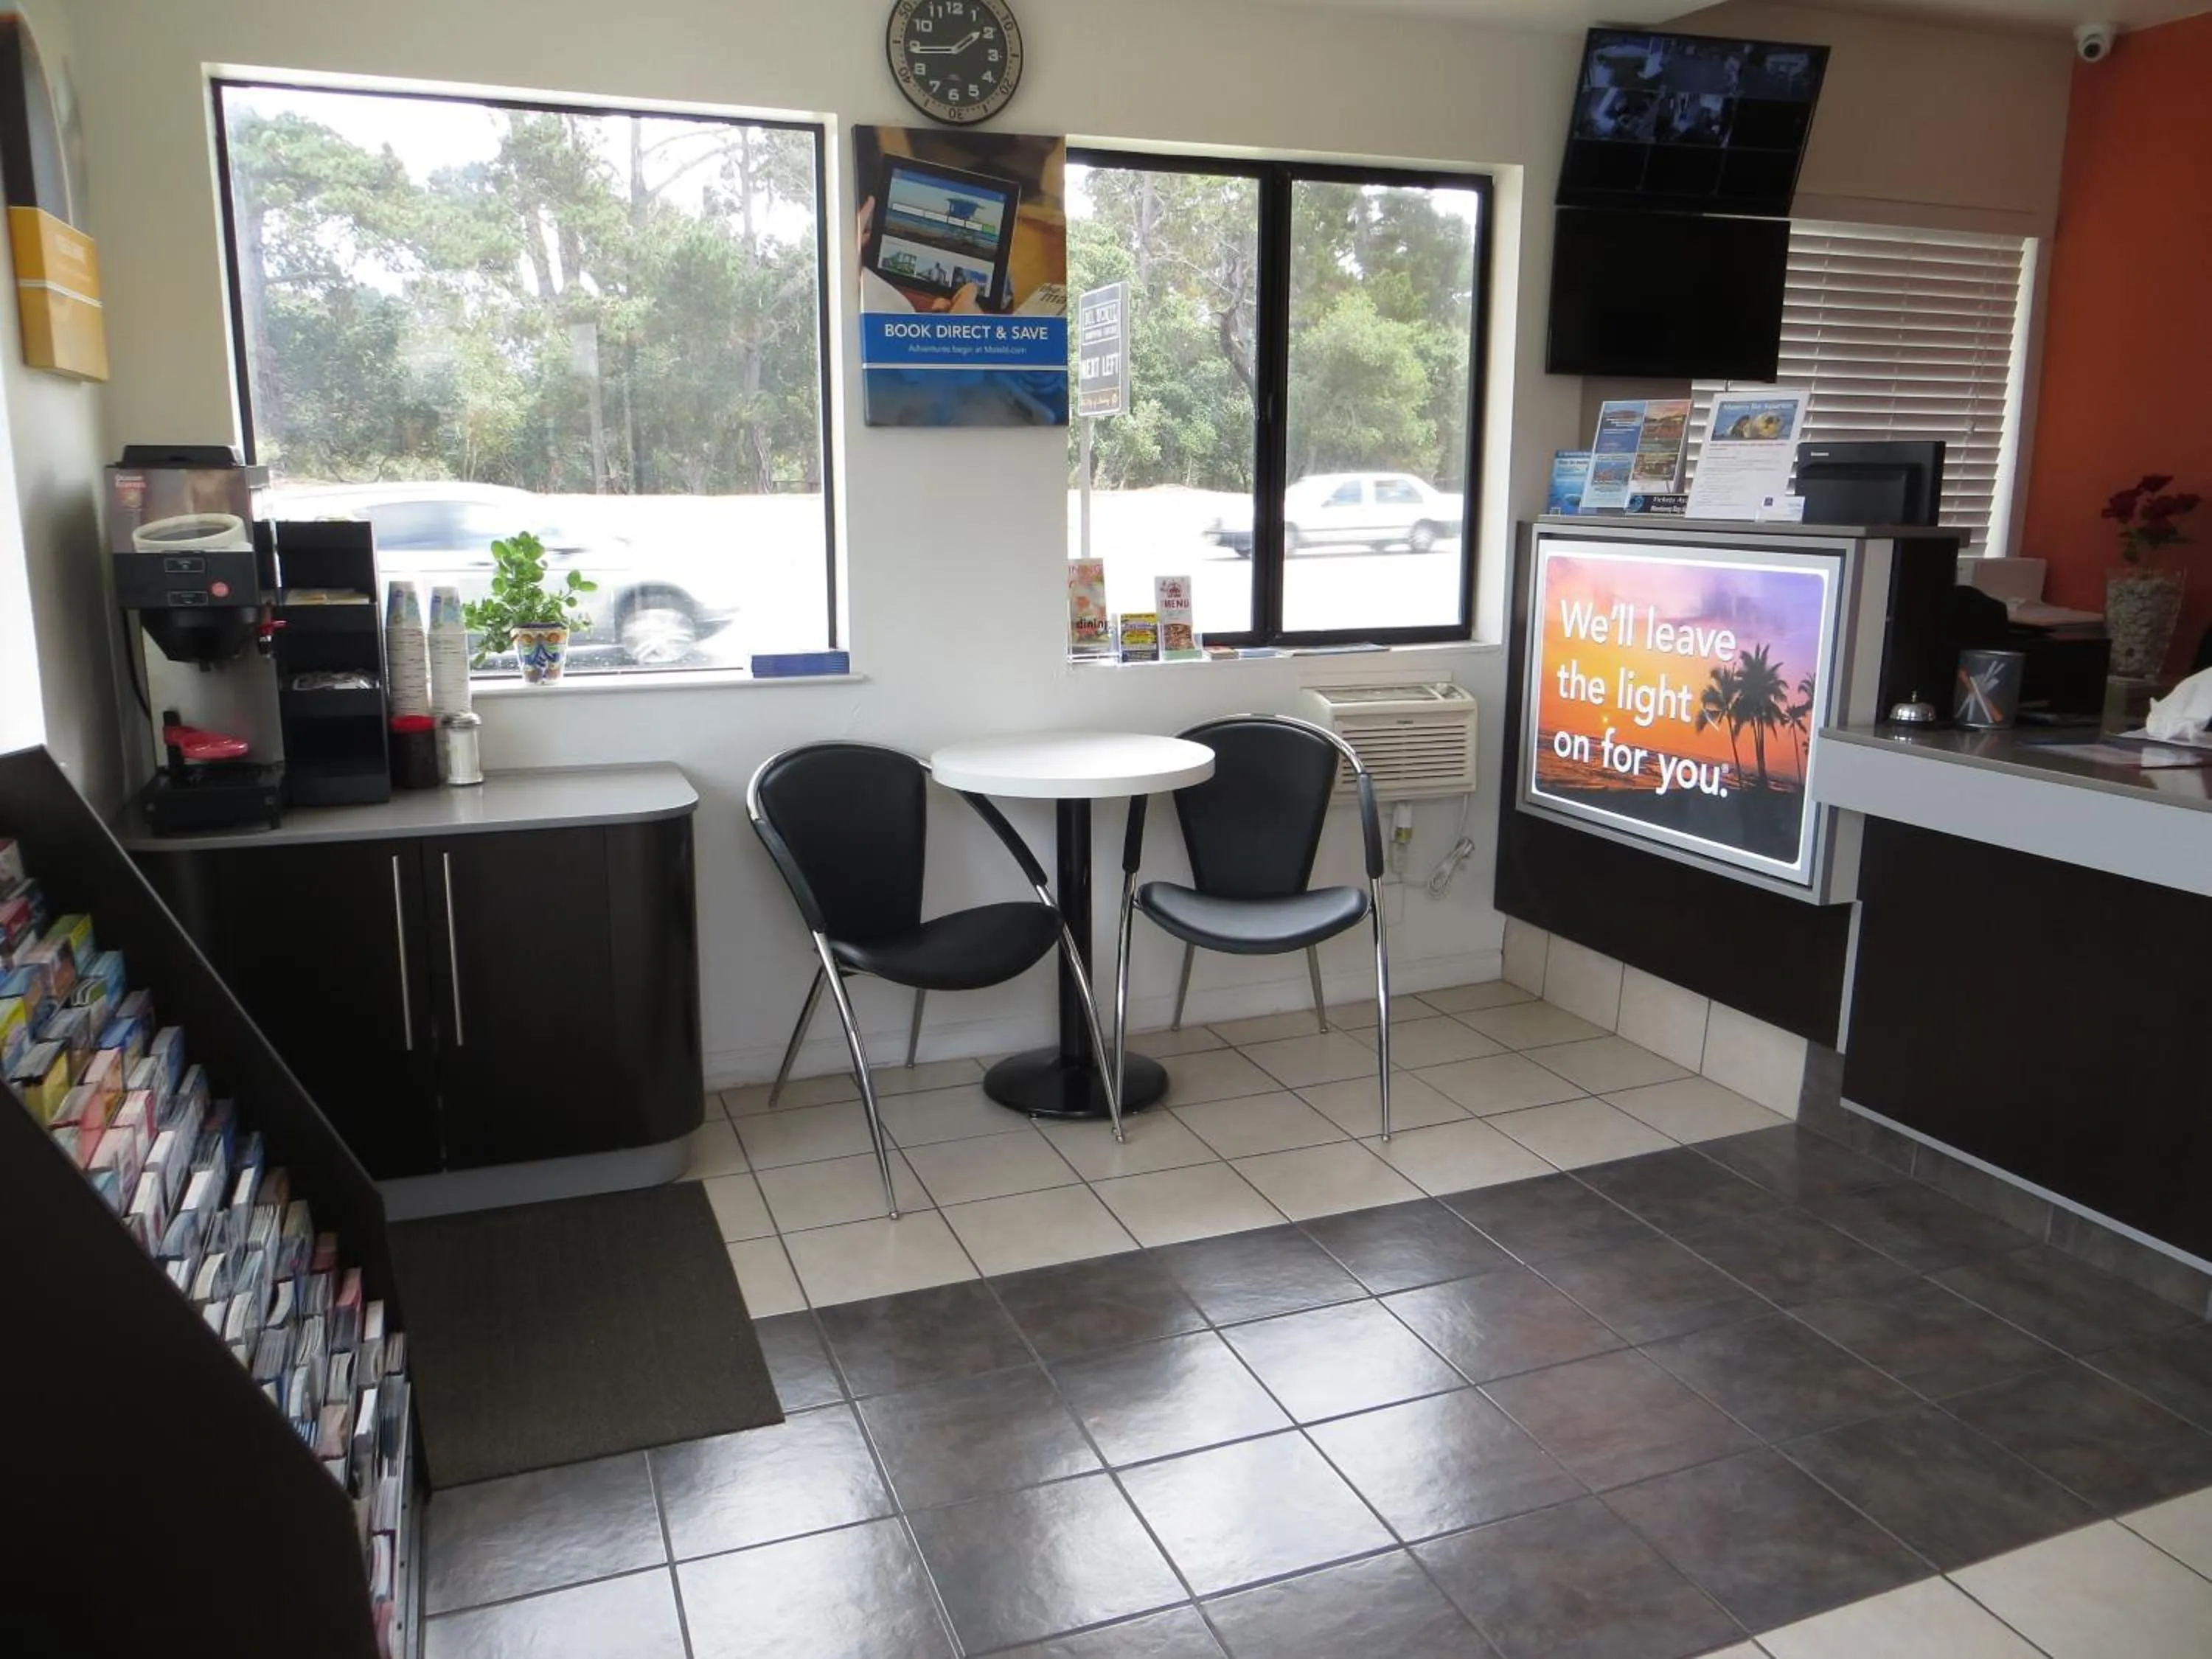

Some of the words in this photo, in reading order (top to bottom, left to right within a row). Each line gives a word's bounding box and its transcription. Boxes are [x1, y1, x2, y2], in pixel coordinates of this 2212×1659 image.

[929, 3, 943, 18] 11
[946, 1, 963, 15] 12
[914, 19, 933, 32] 10
[983, 27, 994, 39] 2
[987, 49, 999, 62] 3
[914, 63, 926, 75] 8
[981, 71, 994, 83] 4
[929, 80, 941, 93] 7
[968, 84, 980, 97] 5
[948, 88, 959, 100] 6
[885, 323, 932, 339] BOOK
[936, 324, 990, 340] DIRECT
[995, 325, 1007, 339] &
[1012, 325, 1049, 341] SAVE
[1102, 352, 1119, 376] LEFT
[1164, 598, 1189, 608] MENU
[1560, 599, 1635, 647] We'll
[1646, 605, 1736, 662] leave
[1557, 659, 1606, 706] the
[1617, 667, 1694, 727] light
[1554, 730, 1590, 764] on
[1601, 727, 1648, 776] for
